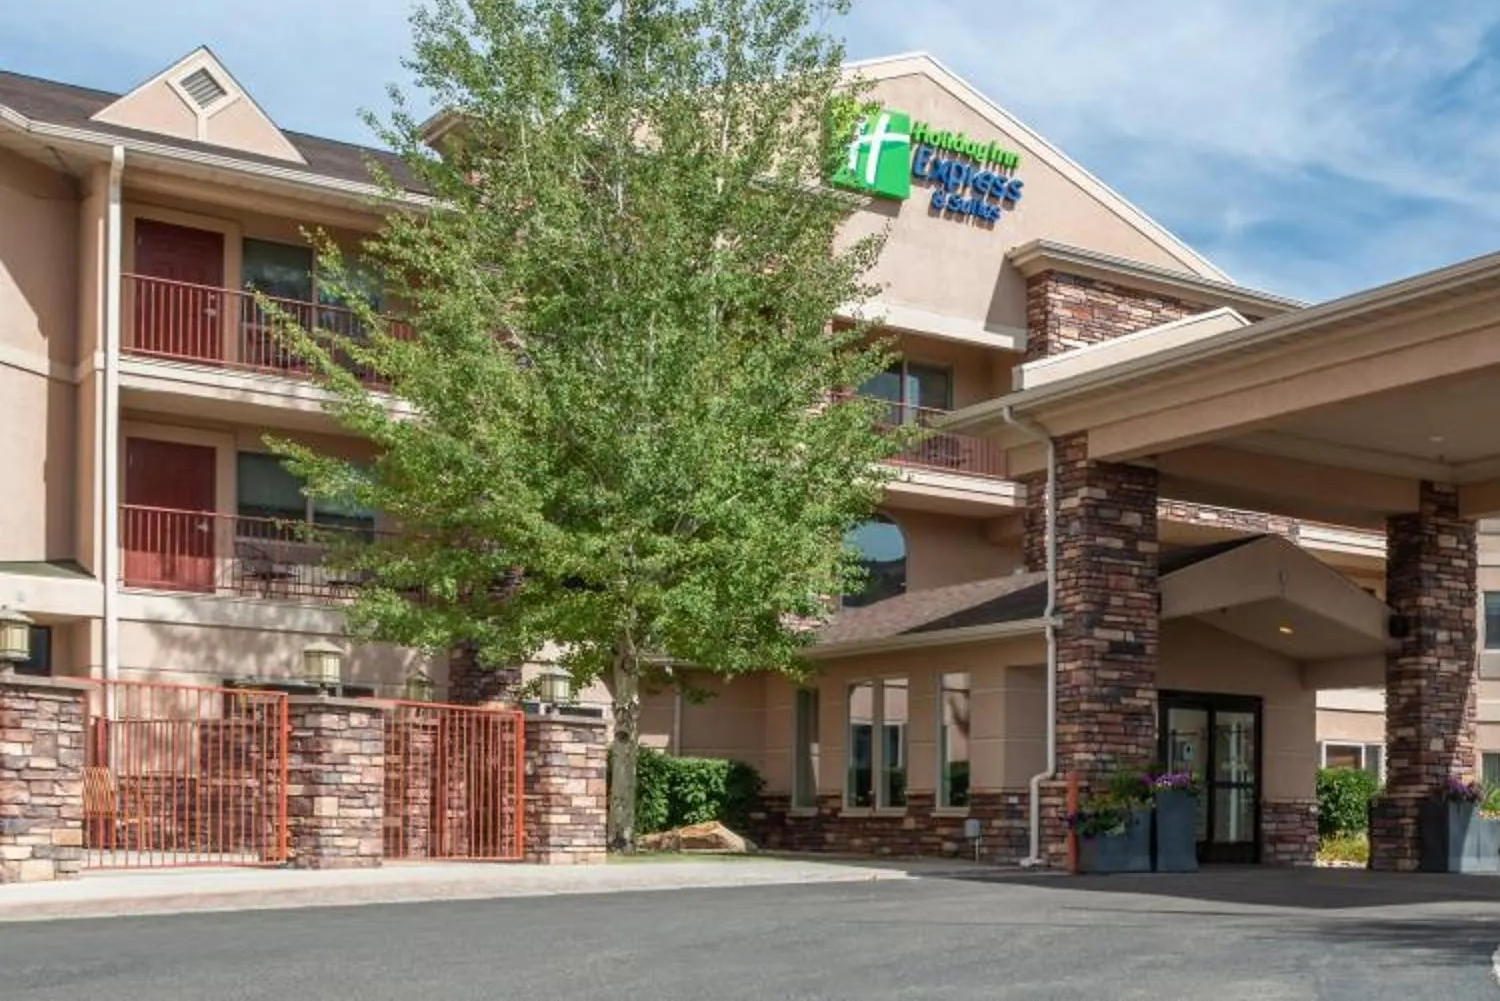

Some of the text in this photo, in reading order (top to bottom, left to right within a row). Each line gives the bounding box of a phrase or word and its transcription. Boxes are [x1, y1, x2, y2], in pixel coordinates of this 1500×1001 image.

[911, 121, 1020, 171] Holiday Inn
[911, 144, 1025, 202] Express
[931, 189, 1001, 223] & Suites
